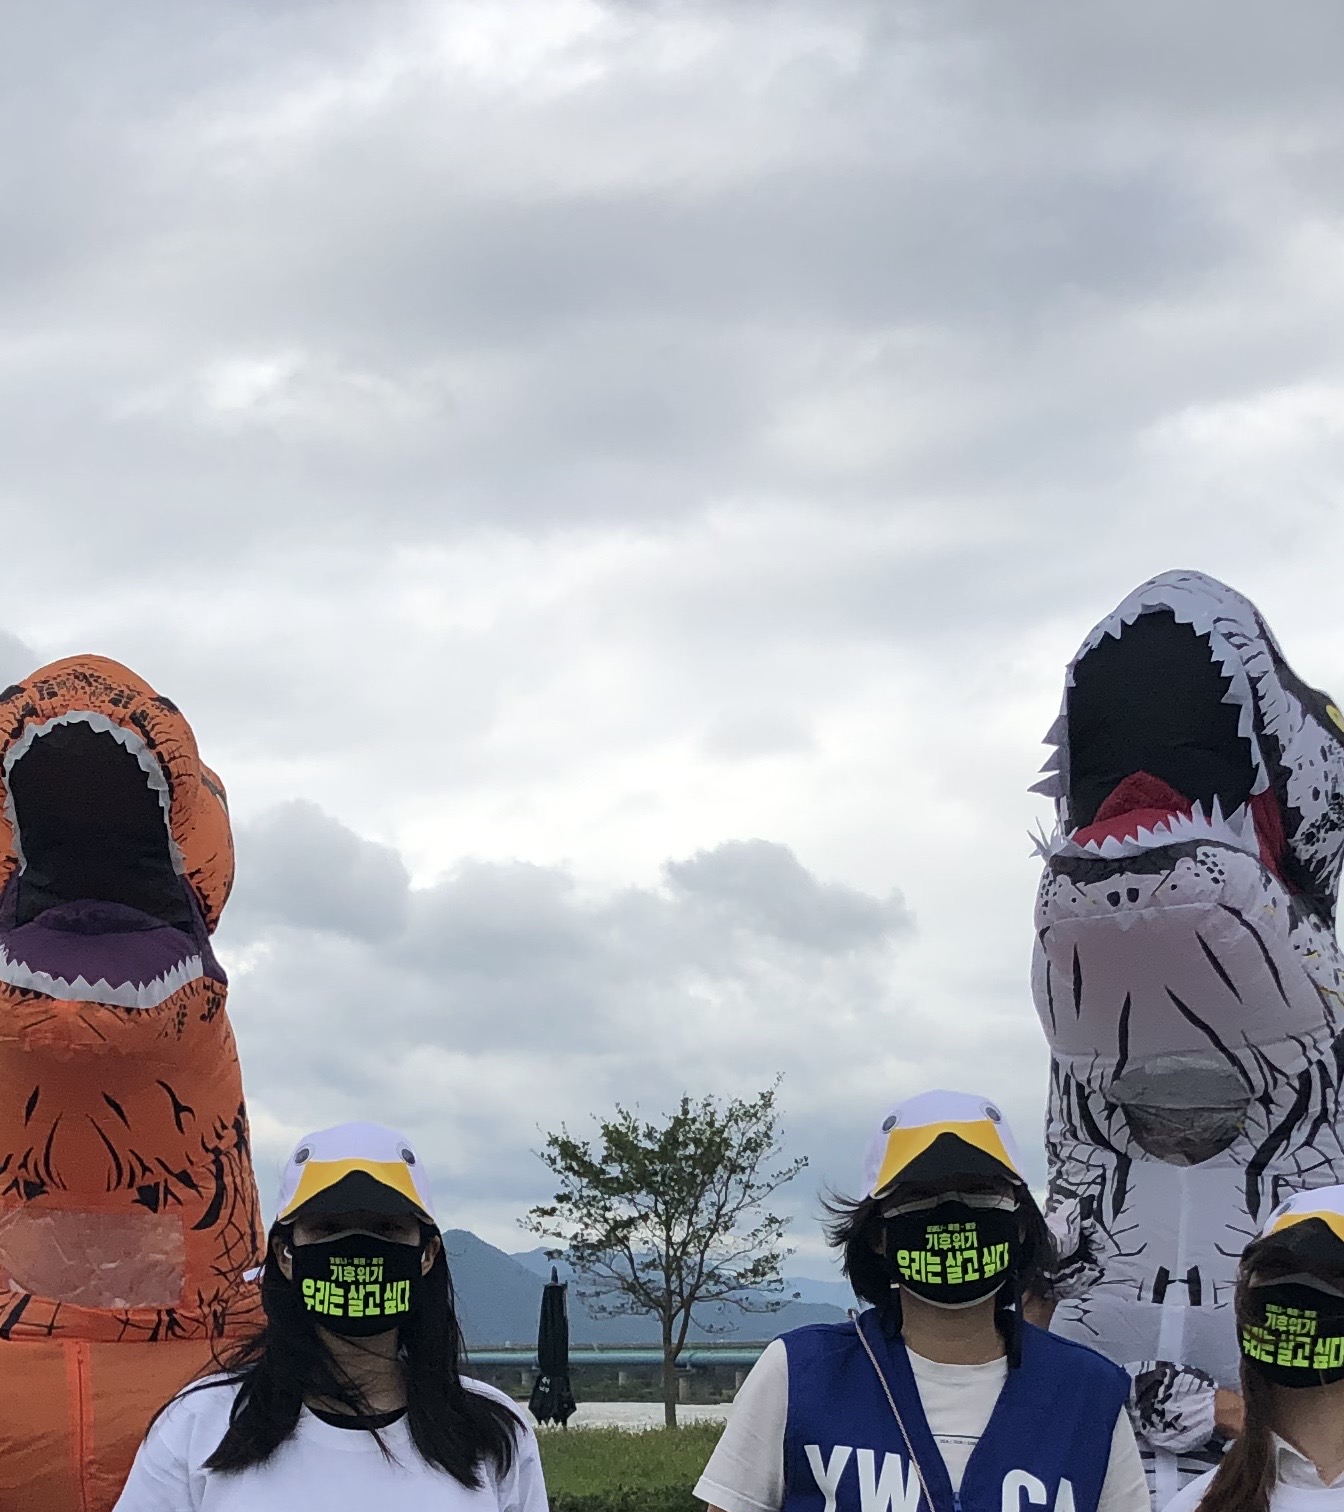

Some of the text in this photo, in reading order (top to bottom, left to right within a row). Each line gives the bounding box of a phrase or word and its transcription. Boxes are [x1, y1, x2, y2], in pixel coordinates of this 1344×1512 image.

[925, 1230, 978, 1250] 기후위기
[329, 1265, 383, 1282] 기후위기
[896, 1242, 1009, 1284] 우리는 살고 싶다
[302, 1278, 410, 1317] 우리는 살고 싶다
[1265, 1312, 1317, 1335] 기후위기
[1277, 1334, 1311, 1367] 살고
